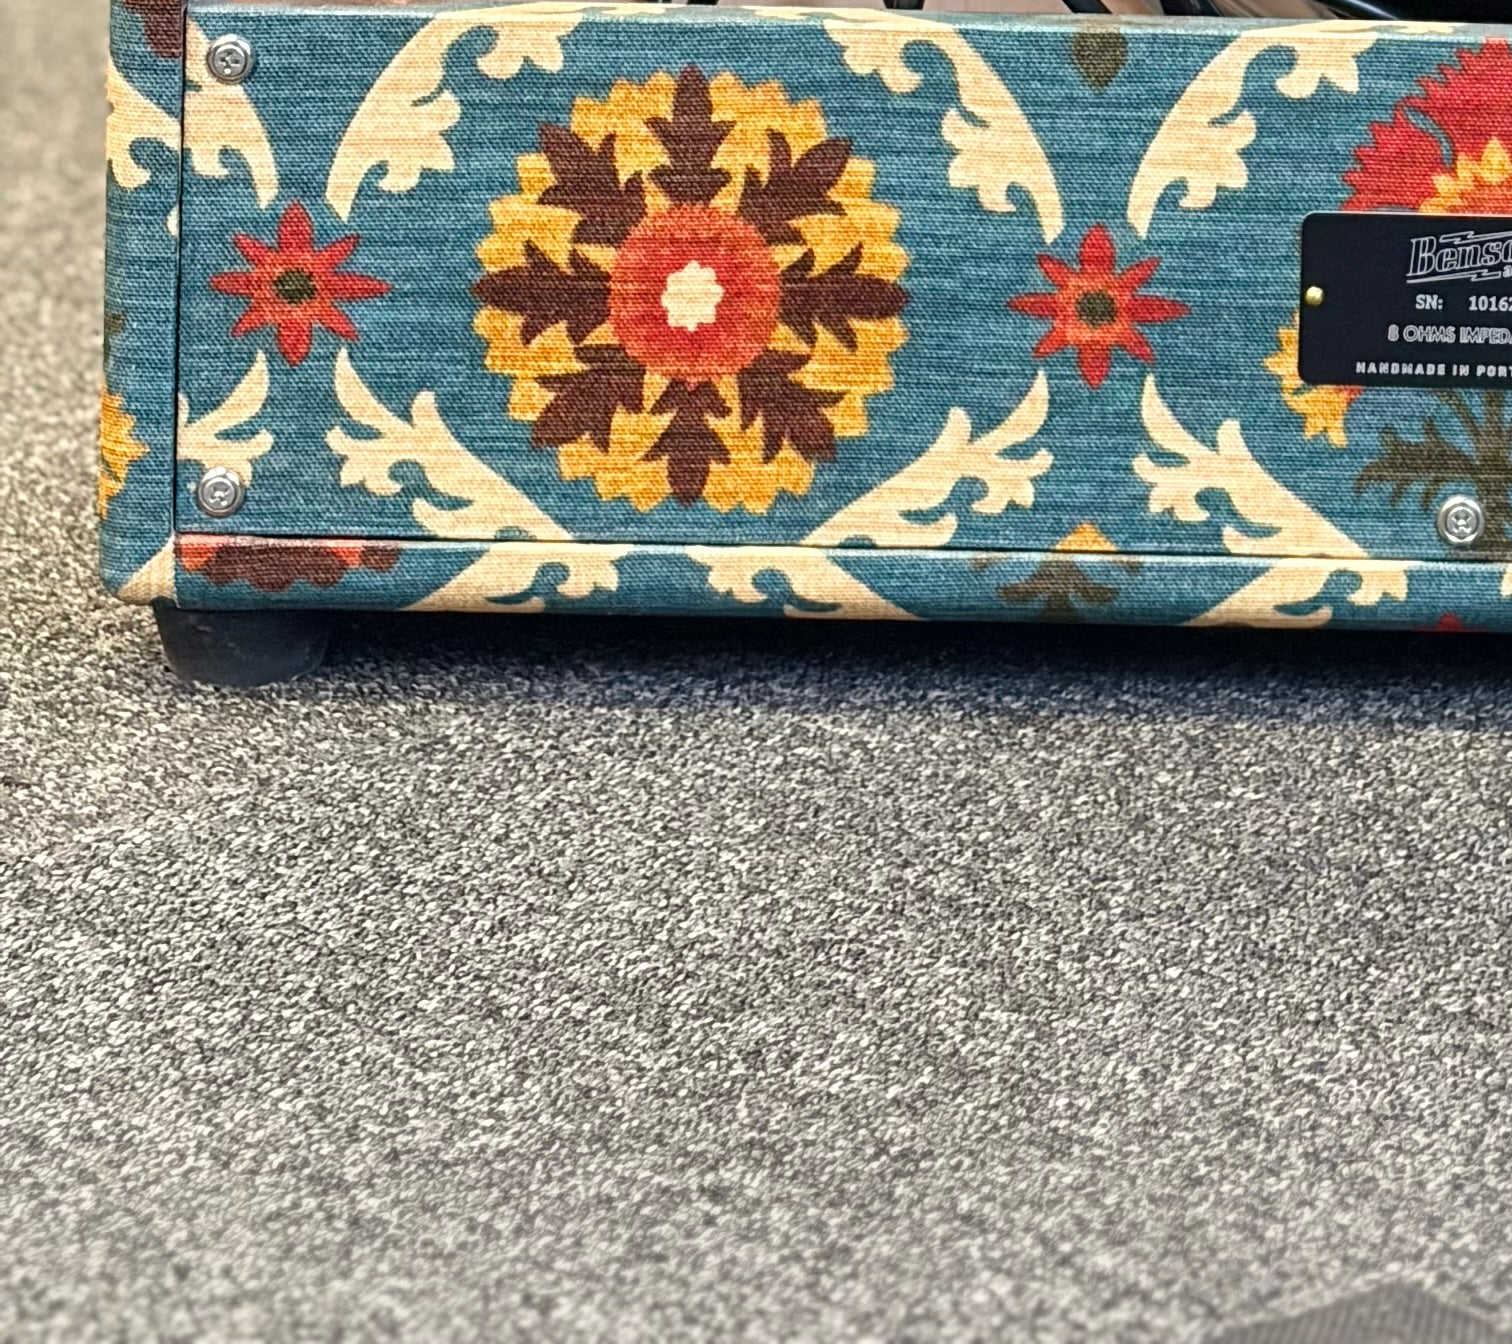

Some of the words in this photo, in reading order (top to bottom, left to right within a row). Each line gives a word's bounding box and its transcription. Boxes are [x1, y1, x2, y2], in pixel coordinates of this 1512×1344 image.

[1415, 294, 1444, 310] SN:
[1387, 324, 1399, 342] 8
[1403, 325, 1456, 343] OHMS
[1356, 362, 1446, 376] HANDMADE
[1452, 364, 1470, 376] IN
